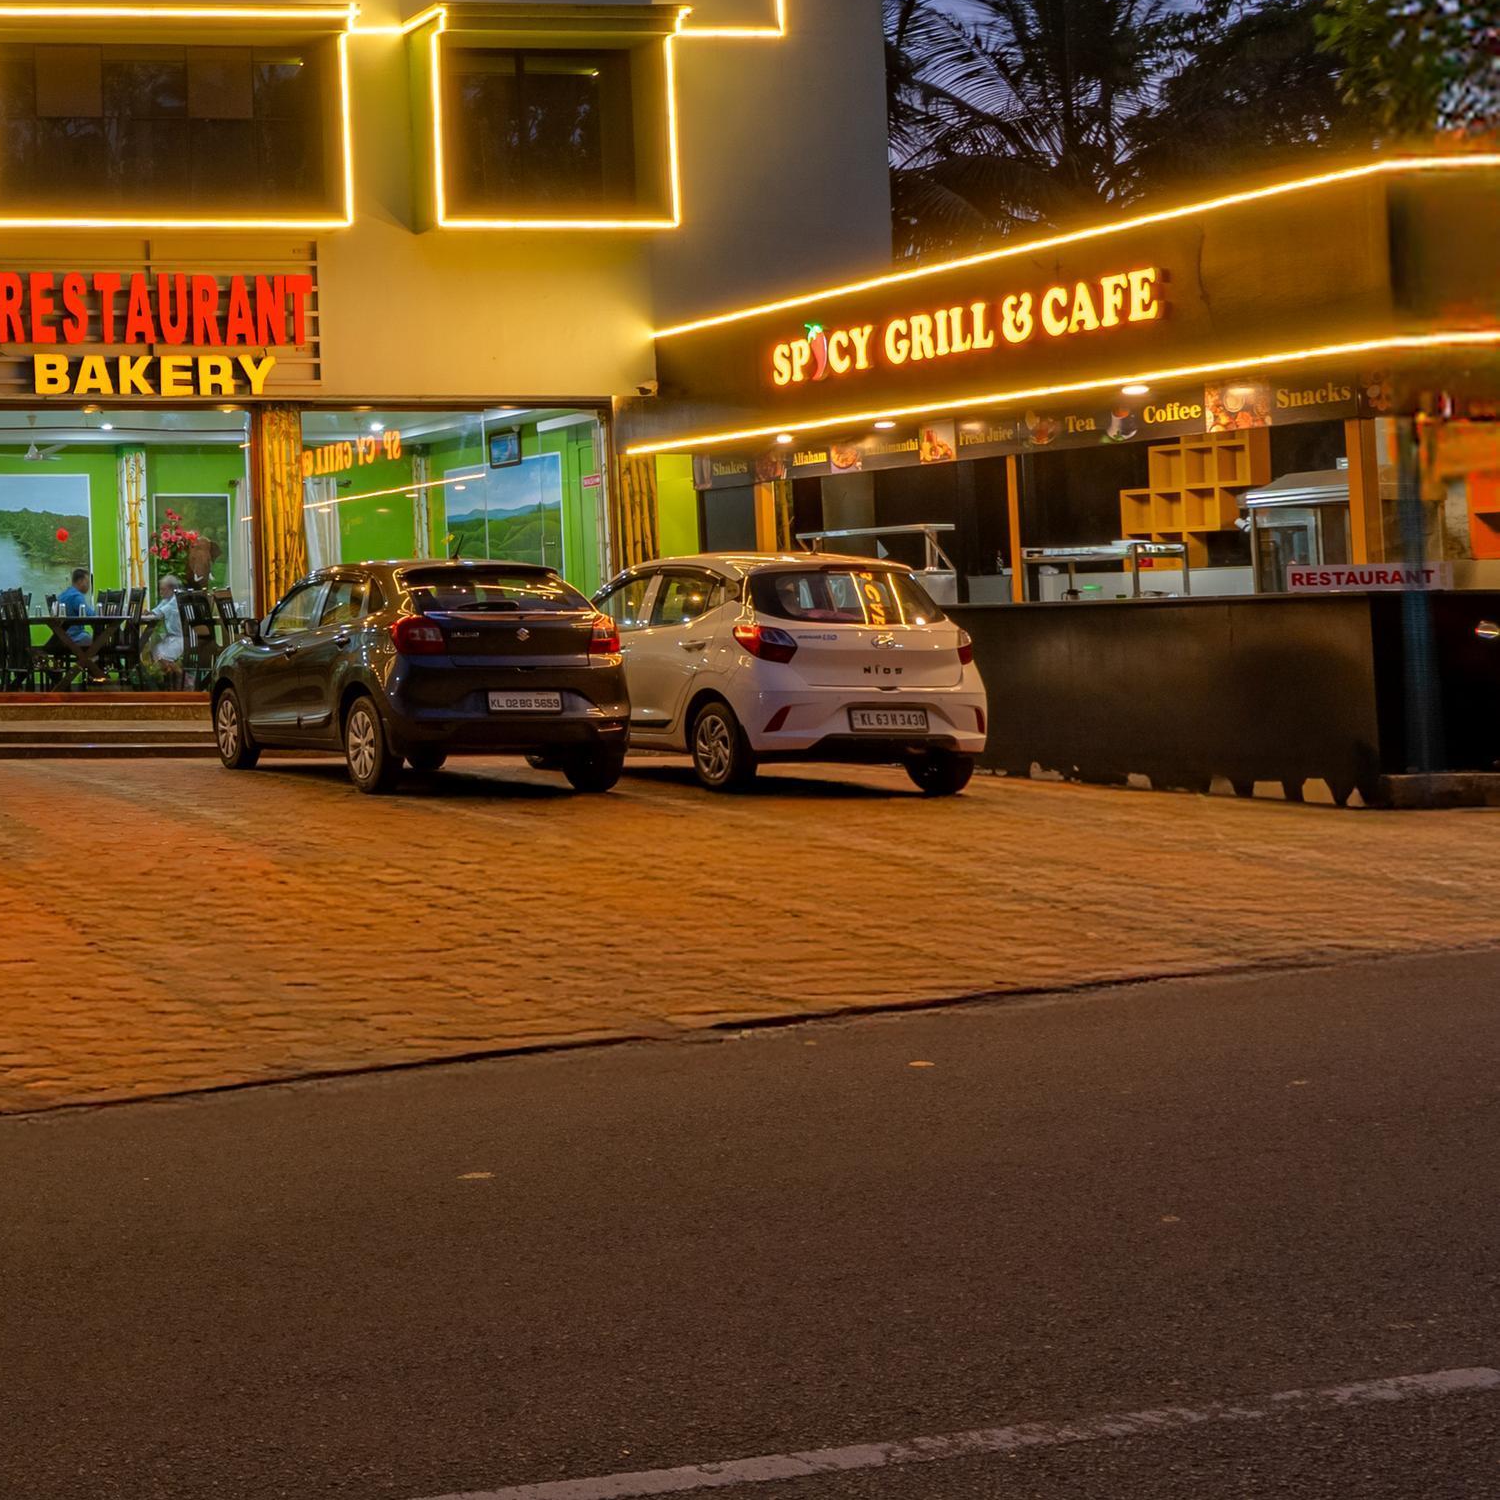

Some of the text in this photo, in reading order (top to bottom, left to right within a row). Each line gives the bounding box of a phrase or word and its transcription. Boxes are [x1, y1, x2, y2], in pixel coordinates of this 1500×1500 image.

[772, 266, 1160, 386] SPICY GRILL & CAFE
[34, 353, 276, 396] BAKERY
[1276, 382, 1351, 409] Snacks
[1143, 402, 1202, 425] Coffee
[1064, 415, 1096, 434] Tea
[712, 460, 748, 477] Shakes
[1291, 569, 1435, 587] RESTAURANT
[860, 715, 873, 726] KL
